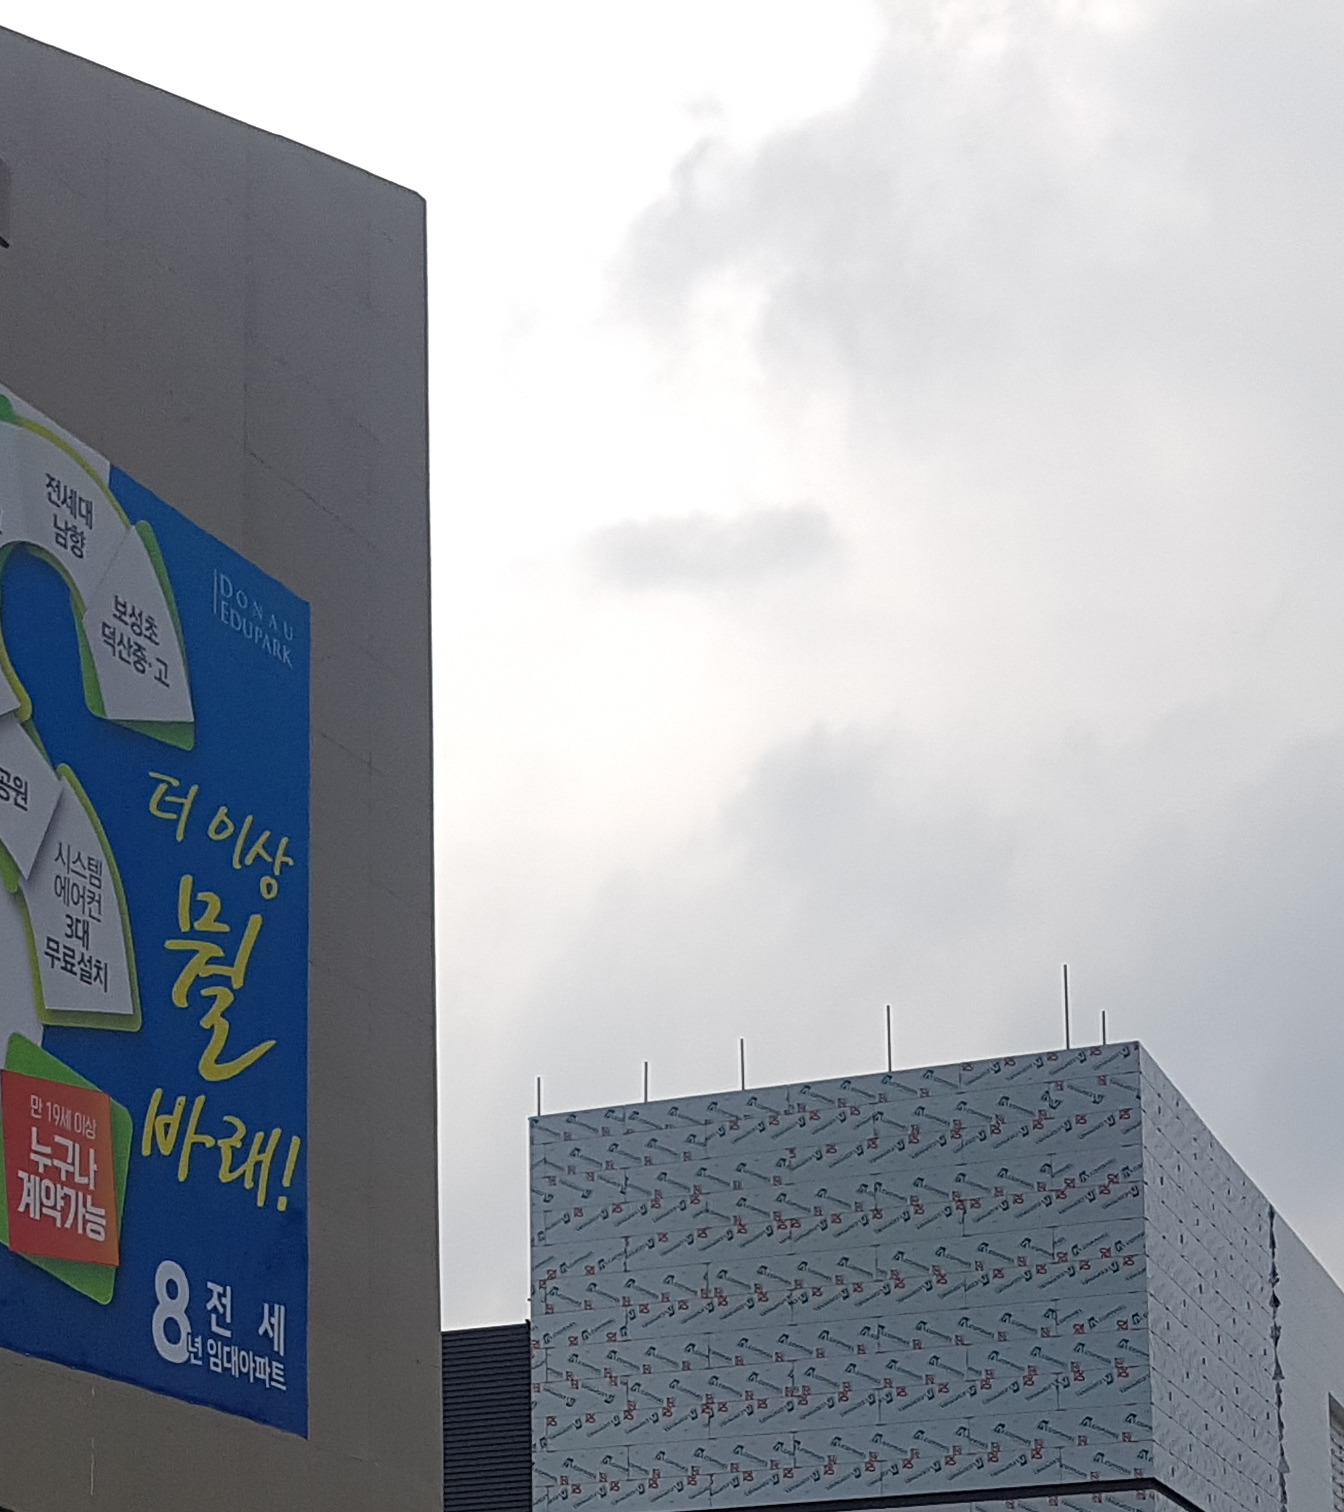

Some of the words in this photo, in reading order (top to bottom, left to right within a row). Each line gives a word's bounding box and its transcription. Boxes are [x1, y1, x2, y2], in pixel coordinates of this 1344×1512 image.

[45, 473, 93, 530] 전세대
[53, 514, 85, 559] 남향
[113, 595, 160, 645] 보성초
[220, 573, 293, 640] DONAU
[221, 601, 293, 670] EDUPARK
[54, 840, 103, 886] 시스템
[148, 771, 198, 842] 더
[208, 806, 293, 899] 이상
[53, 874, 103, 921] 에어컨
[65, 912, 90, 951] 3대
[43, 935, 109, 993] 무료설치
[72, 1112, 97, 1139] 이상
[30, 1126, 98, 1191] 누구나
[17, 1170, 107, 1240] 계약가능
[206, 1336, 287, 1392] 임대아파트
